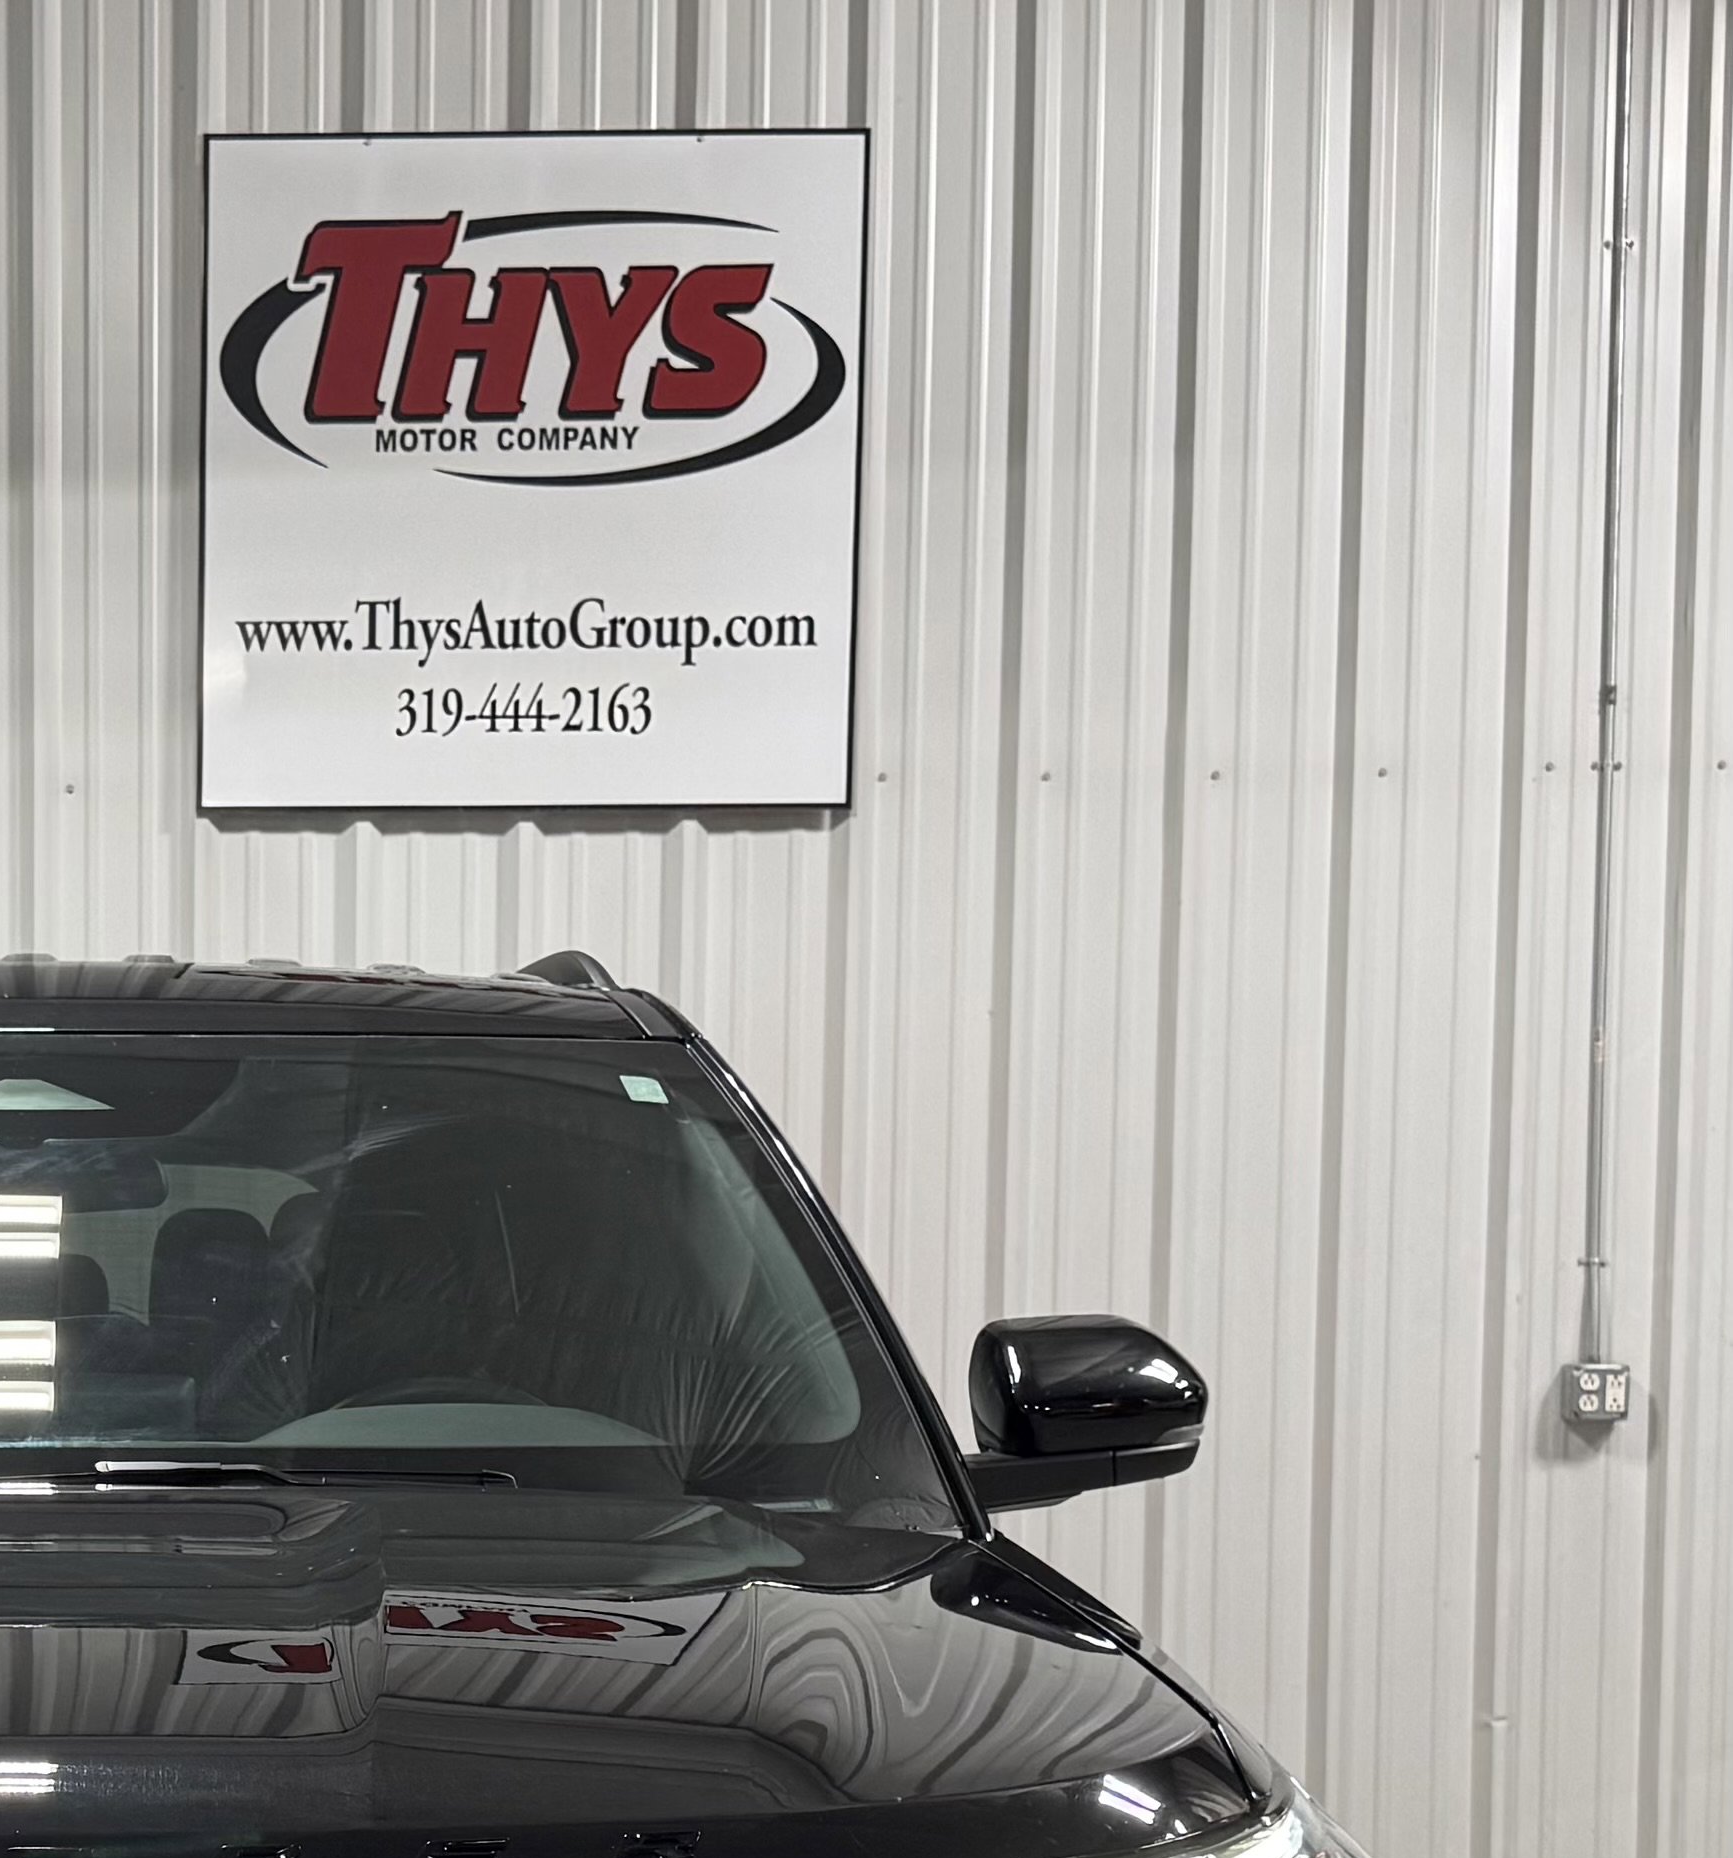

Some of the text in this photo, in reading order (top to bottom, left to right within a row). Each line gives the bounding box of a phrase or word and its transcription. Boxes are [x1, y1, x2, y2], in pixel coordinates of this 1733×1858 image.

[295, 209, 775, 423] THYS
[375, 425, 640, 453] MOTOR COMPANY
[235, 597, 818, 667] www.ThysAutoGroup.com
[395, 683, 653, 737] 319-444-2163
